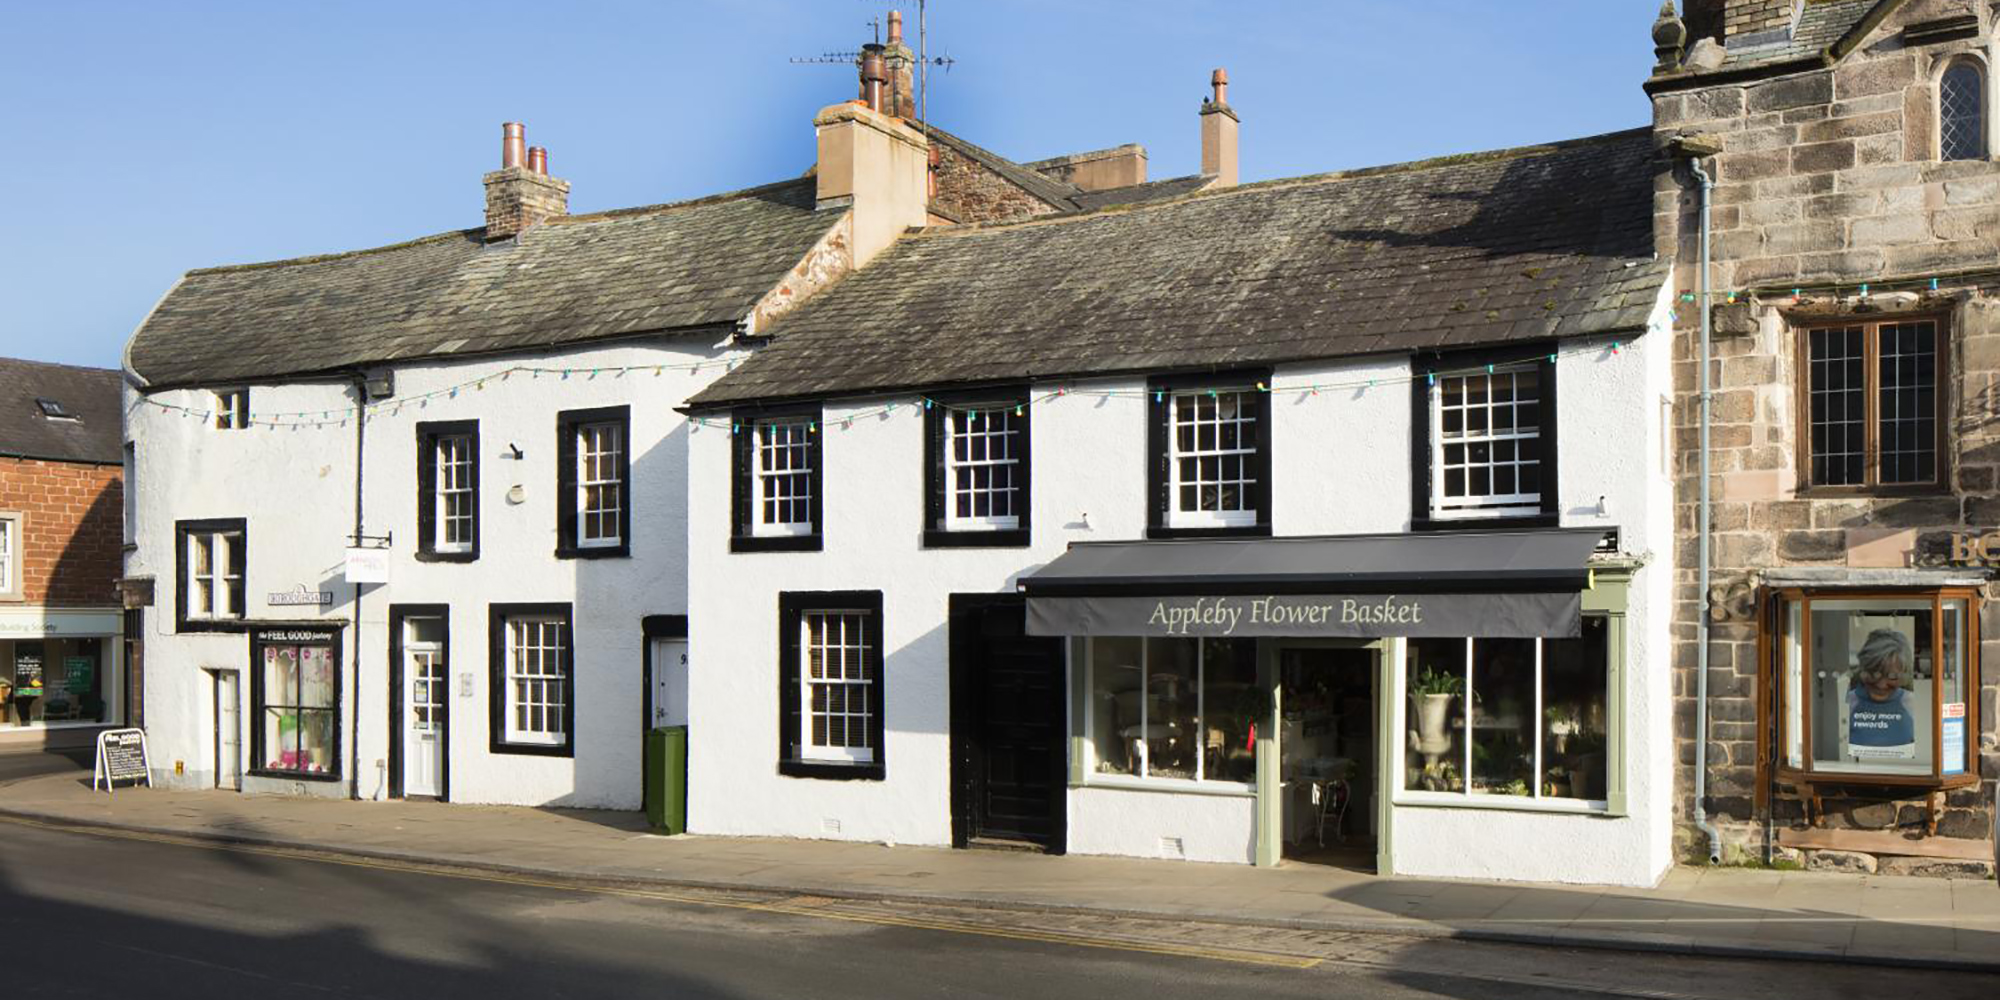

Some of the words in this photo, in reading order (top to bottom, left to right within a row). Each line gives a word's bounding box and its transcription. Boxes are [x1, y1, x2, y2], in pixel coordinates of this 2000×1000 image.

[1148, 598, 1242, 635] Appleby
[1249, 596, 1332, 623] Flower
[1340, 595, 1423, 623] Basket
[31, 620, 57, 632] Society
[267, 631, 287, 640] FEEL
[287, 631, 312, 640] GOOD
[680, 653, 688, 665] 9
[1853, 711, 1877, 721] enjoy
[1853, 720, 1889, 729] rewards
